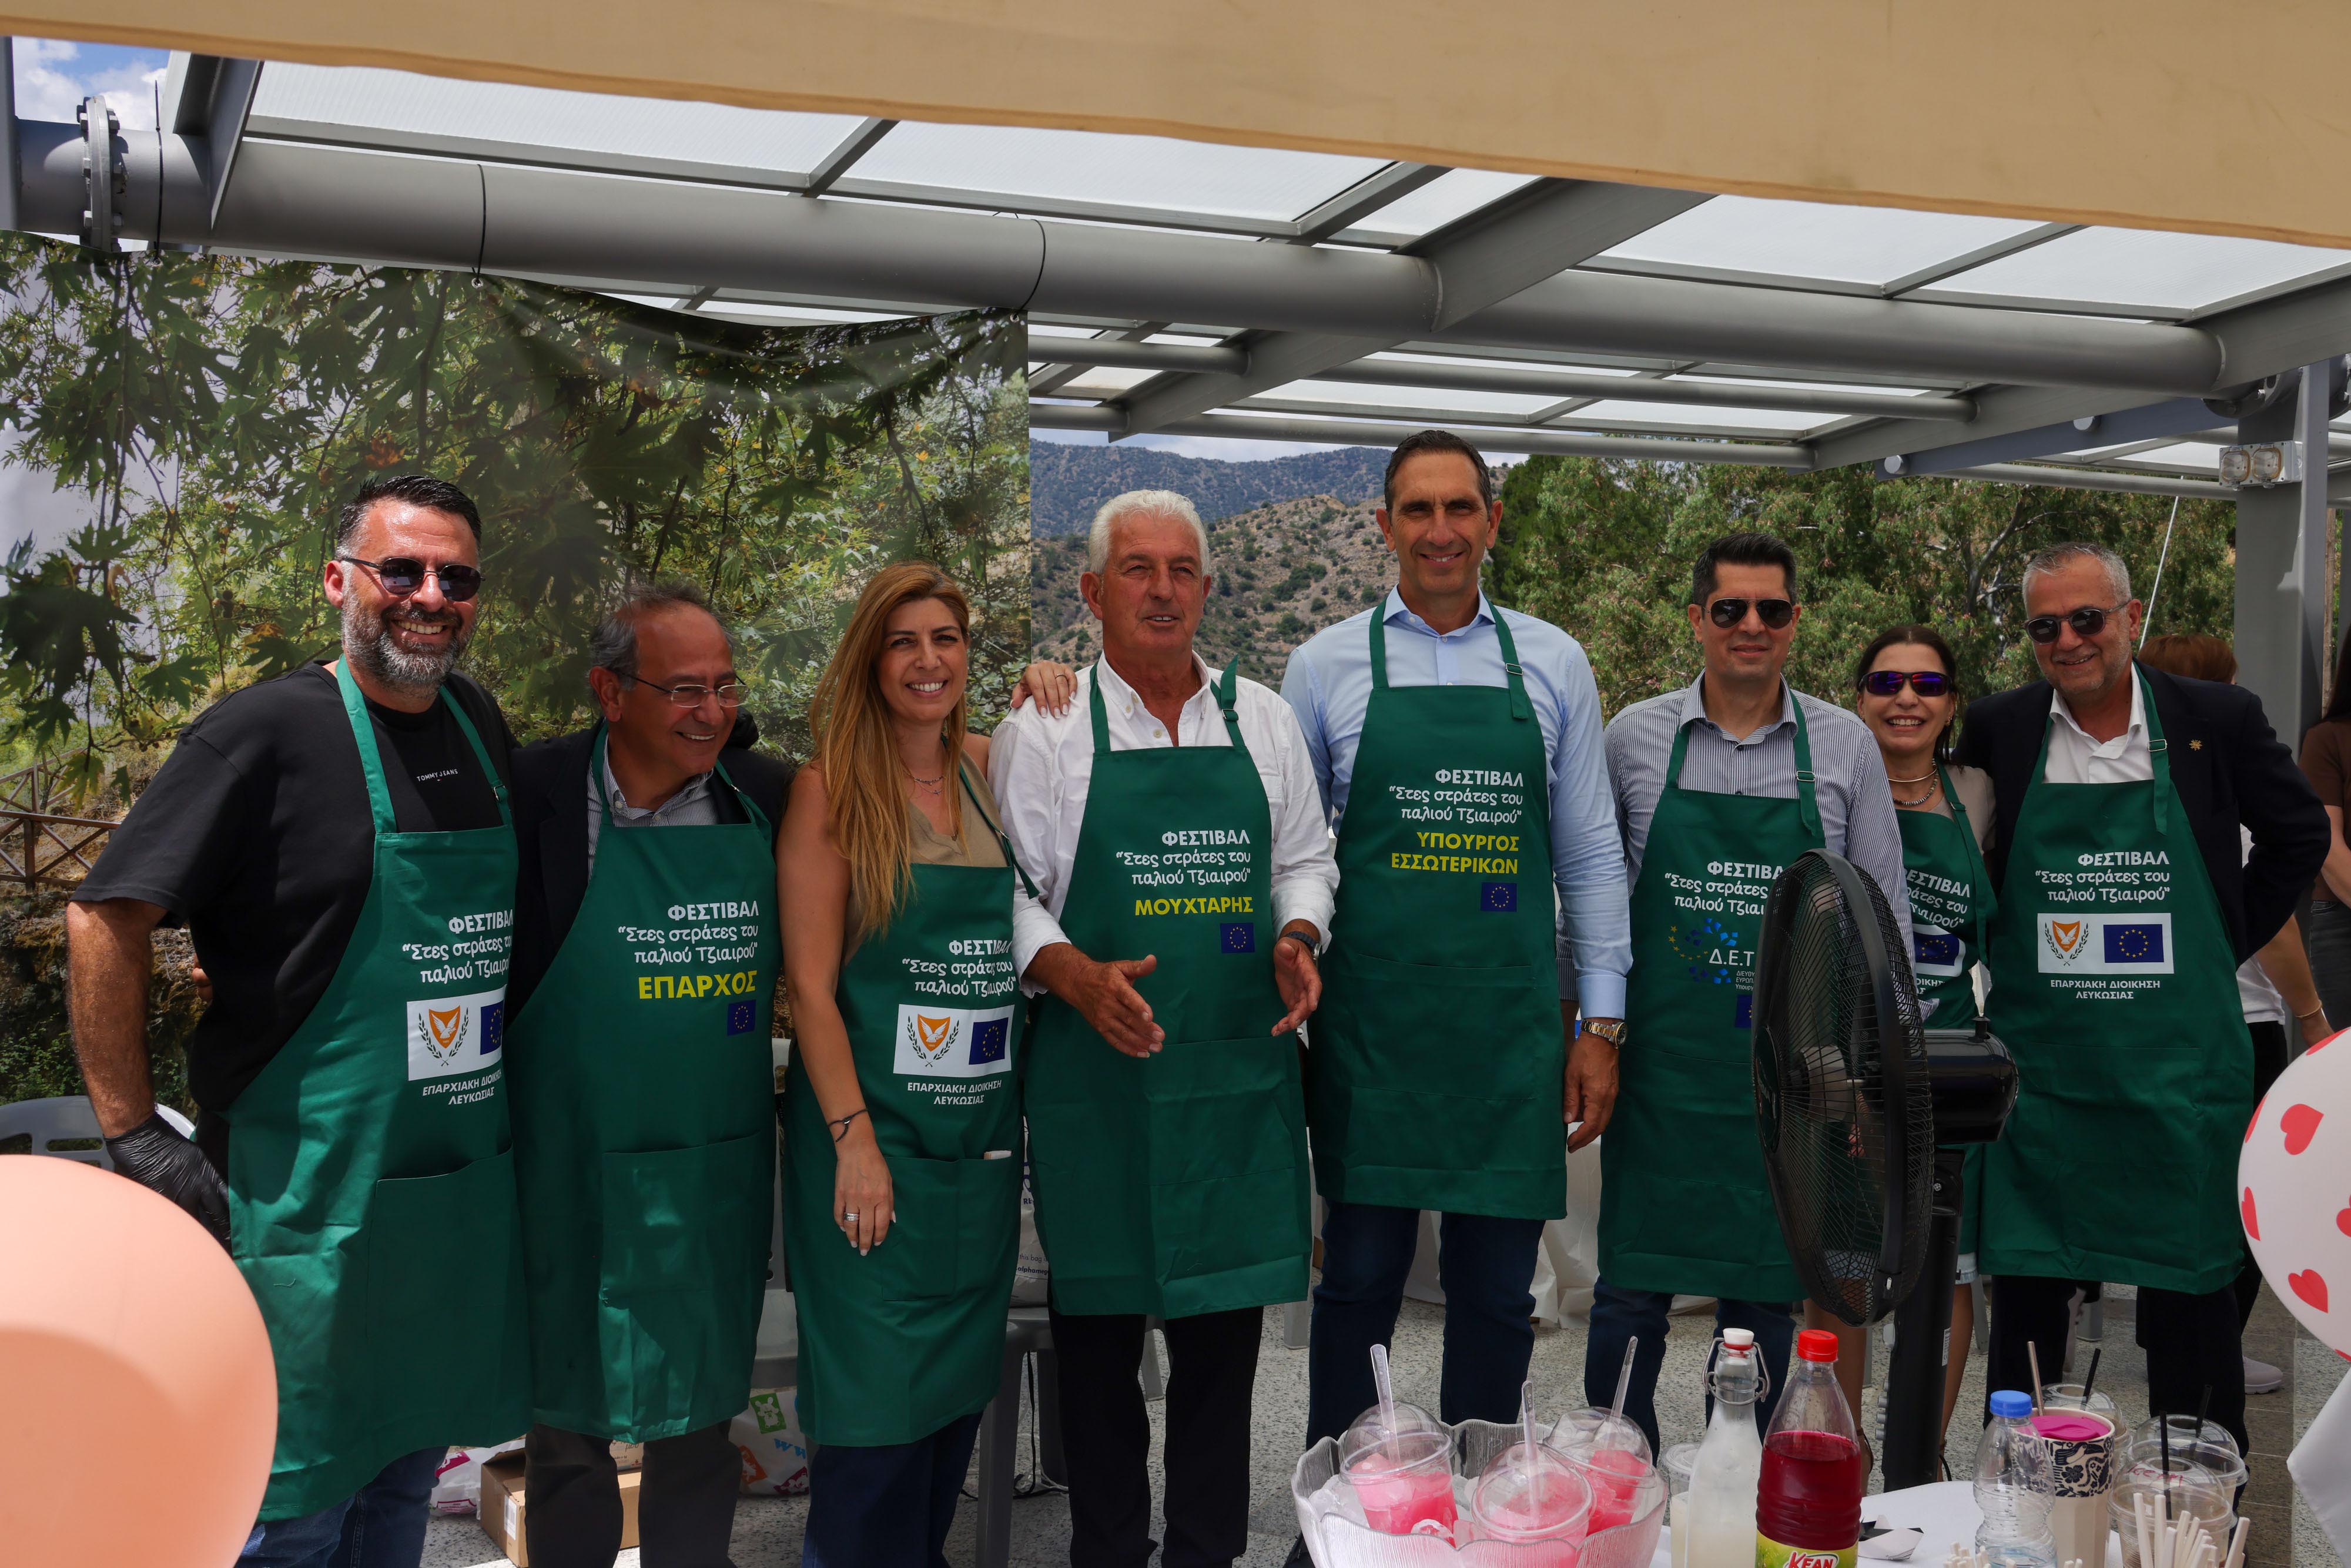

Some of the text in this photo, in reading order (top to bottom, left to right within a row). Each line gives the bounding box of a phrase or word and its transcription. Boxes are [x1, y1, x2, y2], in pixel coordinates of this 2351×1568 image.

[417, 769, 458, 782] TOMMY JEANS
[1435, 769, 1523, 787] ΦΕΣΤΙΒΑΛ
[1434, 788, 1498, 806] στράτες
[1501, 794, 1523, 805] του
[1401, 806, 1452, 822] παλιού
[1161, 829, 1251, 846] ΦΕΣΤΙΒΑΛ
[1416, 832, 1520, 852] ΥΠΟΥΡΓΟΣ
[1163, 849, 1225, 867] στράτες
[1228, 852, 1250, 863] του
[1391, 853, 1518, 874] ΕΣΣΩΤΕΡΙΚΩΝ
[2078, 851, 2169, 866] ΦΕΣΤΙΒΑΛ
[1131, 869, 1184, 887] παλιού
[1707, 861, 1784, 880] ΦΕΣΤΙΒΑ
[2077, 869, 2139, 886] στράτες
[2144, 872, 2169, 882] του
[1706, 880, 1769, 899] στράτες
[1906, 869, 1970, 898] ΕΣΤΙΒΑΛ
[2048, 887, 2095, 903] παλιού
[668, 900, 759, 921] ΦΕΣΤΙΒΑΛ
[1135, 896, 1254, 916] ΜΟΥΧΤΑΡΗΣ
[1674, 895, 1764, 916] παλιού Τζιαι
[1947, 900, 1967, 914] του
[448, 909, 513, 934] ΦΕΣΤΙΒΑΛ
[669, 923, 738, 944] στράτες
[741, 925, 758, 937] του
[453, 936, 503, 958] στράτες
[634, 946, 692, 966] παλιού
[949, 940, 1012, 956] ΦΕΣΤΙΒΑΛ
[996, 961, 1013, 972] του
[1709, 949, 1754, 967] Δ.Ε.Τ
[420, 961, 473, 984] παλιού
[638, 970, 758, 999] ΕΠΑΡΧΟΣ
[915, 980, 969, 996] παλιού
[2051, 980, 2161, 989] ΕΠΑΡΧΙΑΚΗ ΔΙΟΙΚΗΣΗ
[422, 1078, 479, 1096] ΕΠΑΡΧΙΑΚΗ
[907, 1080, 1002, 1093] ΕΠΑΡΧΙΑΚΗ ΔΙΟΙΚΗΣΗ
[448, 1087, 494, 1105] ΛΕΥΚΩΣΙΑΣ
[933, 1095, 984, 1105] ΛΕΥΚΩΣΙΑΣ
[1031, 1254, 1042, 1263] bag
[1789, 1552, 1834, 1568] KEAN
